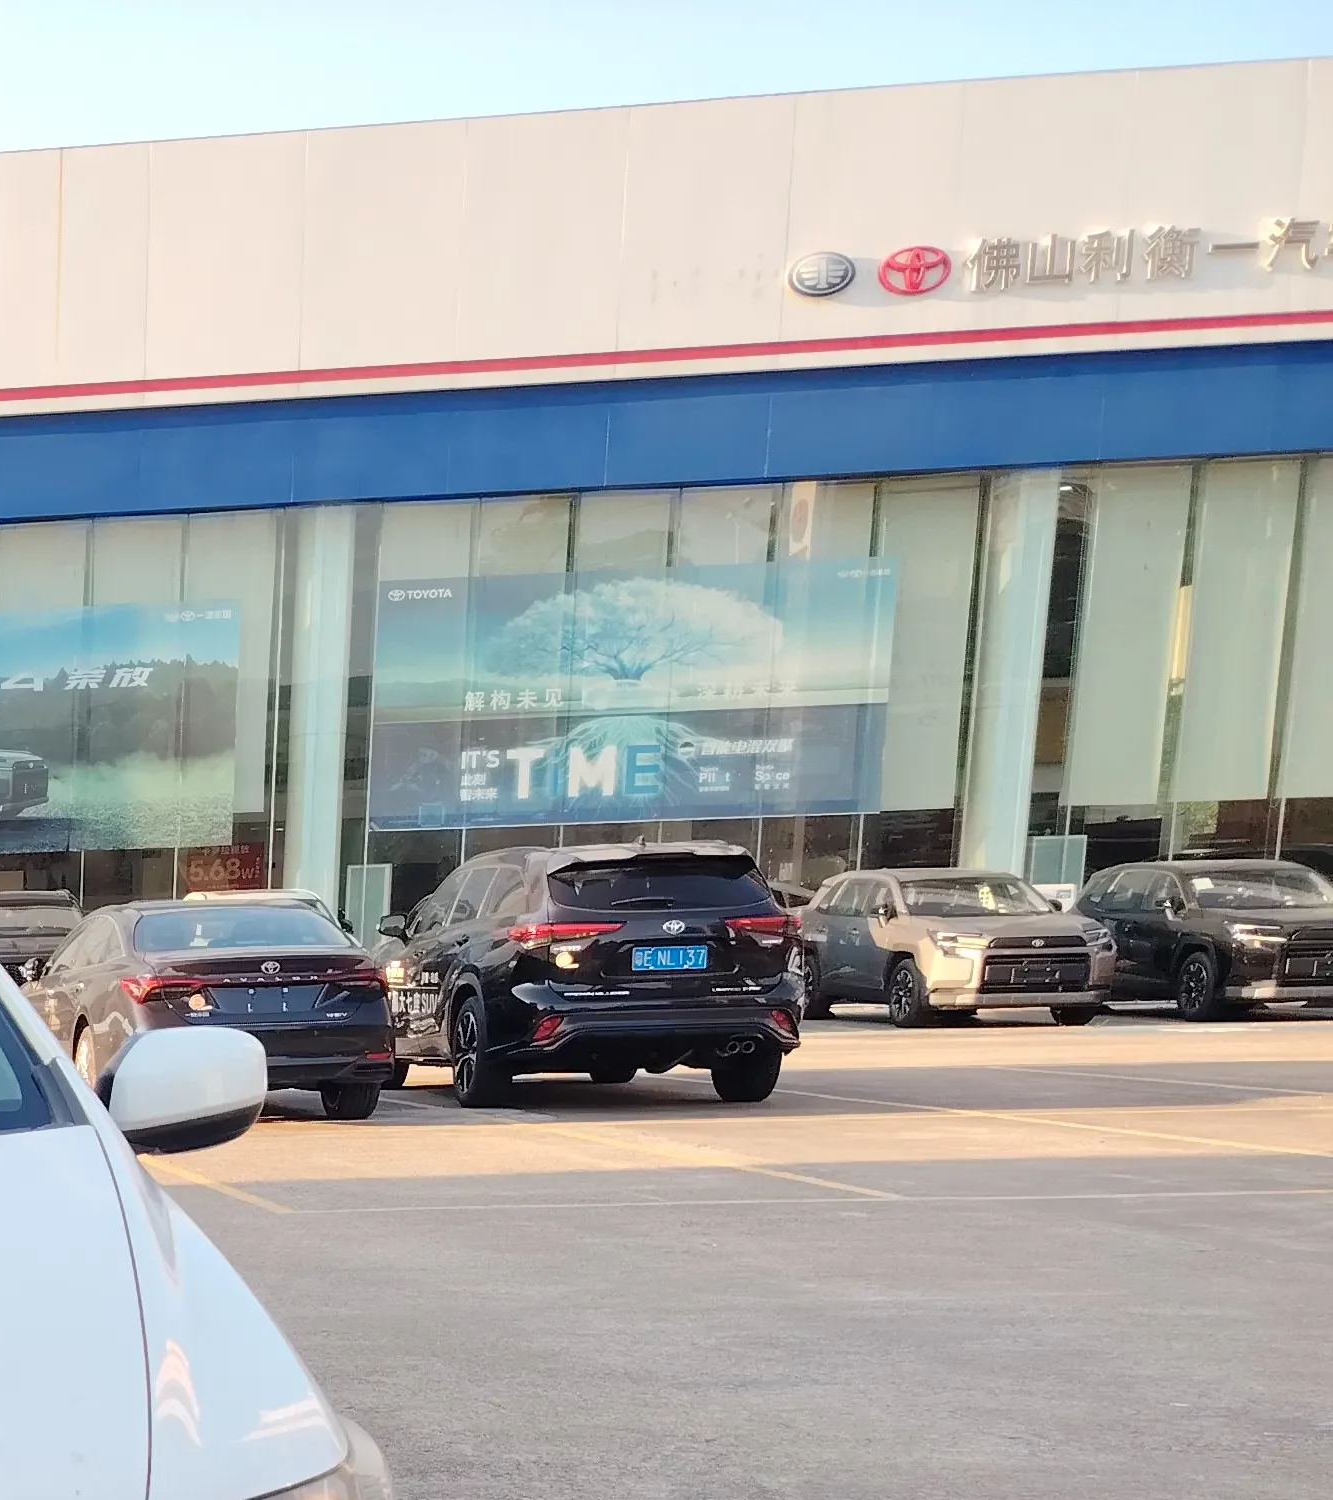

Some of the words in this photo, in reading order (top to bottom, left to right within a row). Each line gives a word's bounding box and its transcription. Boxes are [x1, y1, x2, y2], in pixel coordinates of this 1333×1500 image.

[964, 217, 1333, 293] 佛山利衡一汽
[406, 588, 453, 600] TOYOTA
[63, 666, 154, 691] 荣放
[463, 688, 565, 712] 解构未见
[460, 749, 500, 769] IT'S
[506, 745, 661, 799] TIME
[699, 772, 731, 783] Pilt
